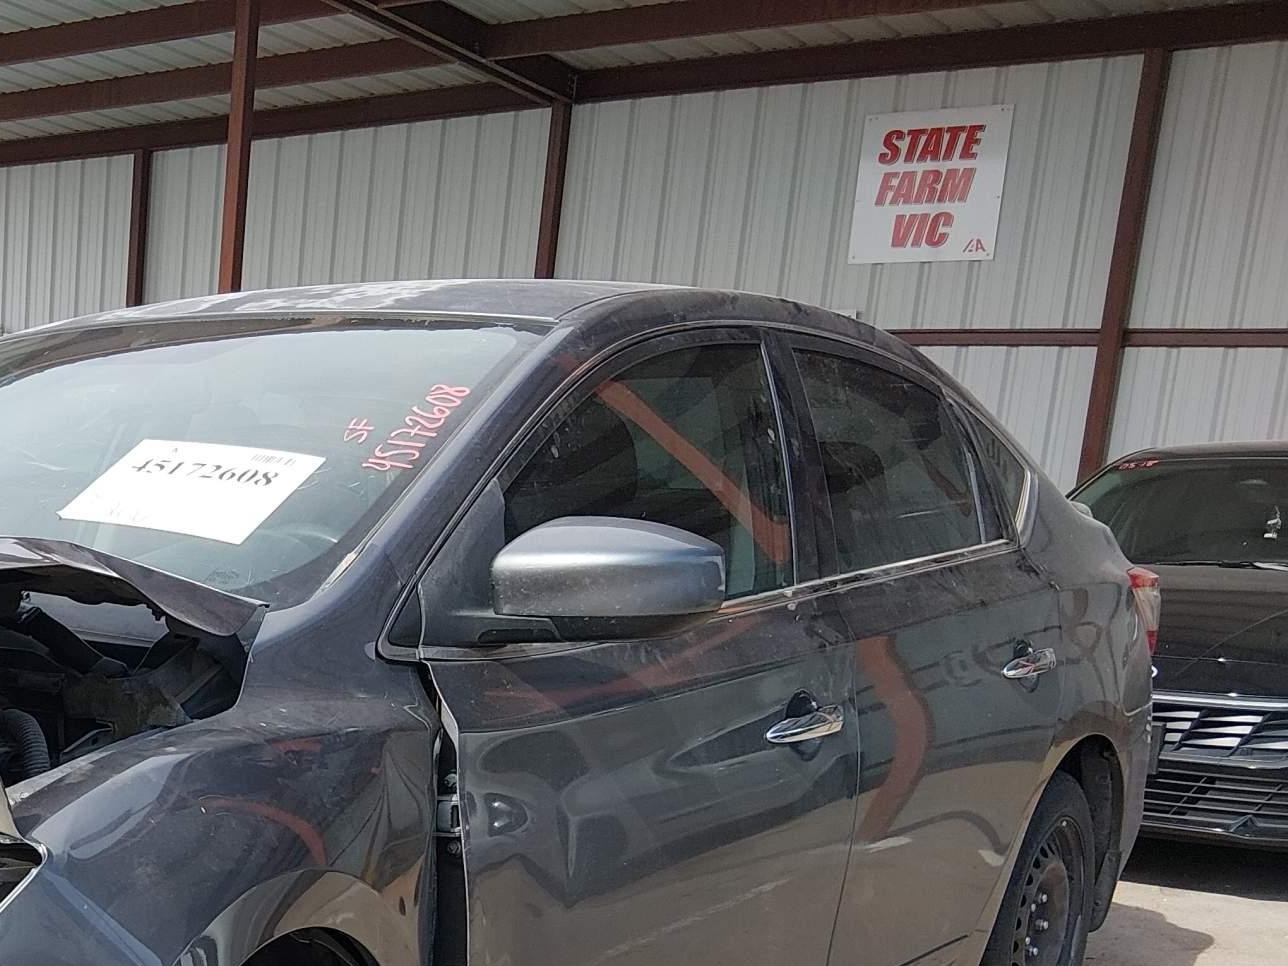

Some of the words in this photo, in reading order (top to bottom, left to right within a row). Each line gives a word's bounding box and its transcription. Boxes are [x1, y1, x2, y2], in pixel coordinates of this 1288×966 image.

[877, 123, 988, 165] STATE
[874, 167, 977, 207] FARM
[891, 211, 955, 249] VIC
[343, 417, 376, 445] SF
[362, 383, 473, 472] 45172608
[130, 456, 280, 488] 45172608
